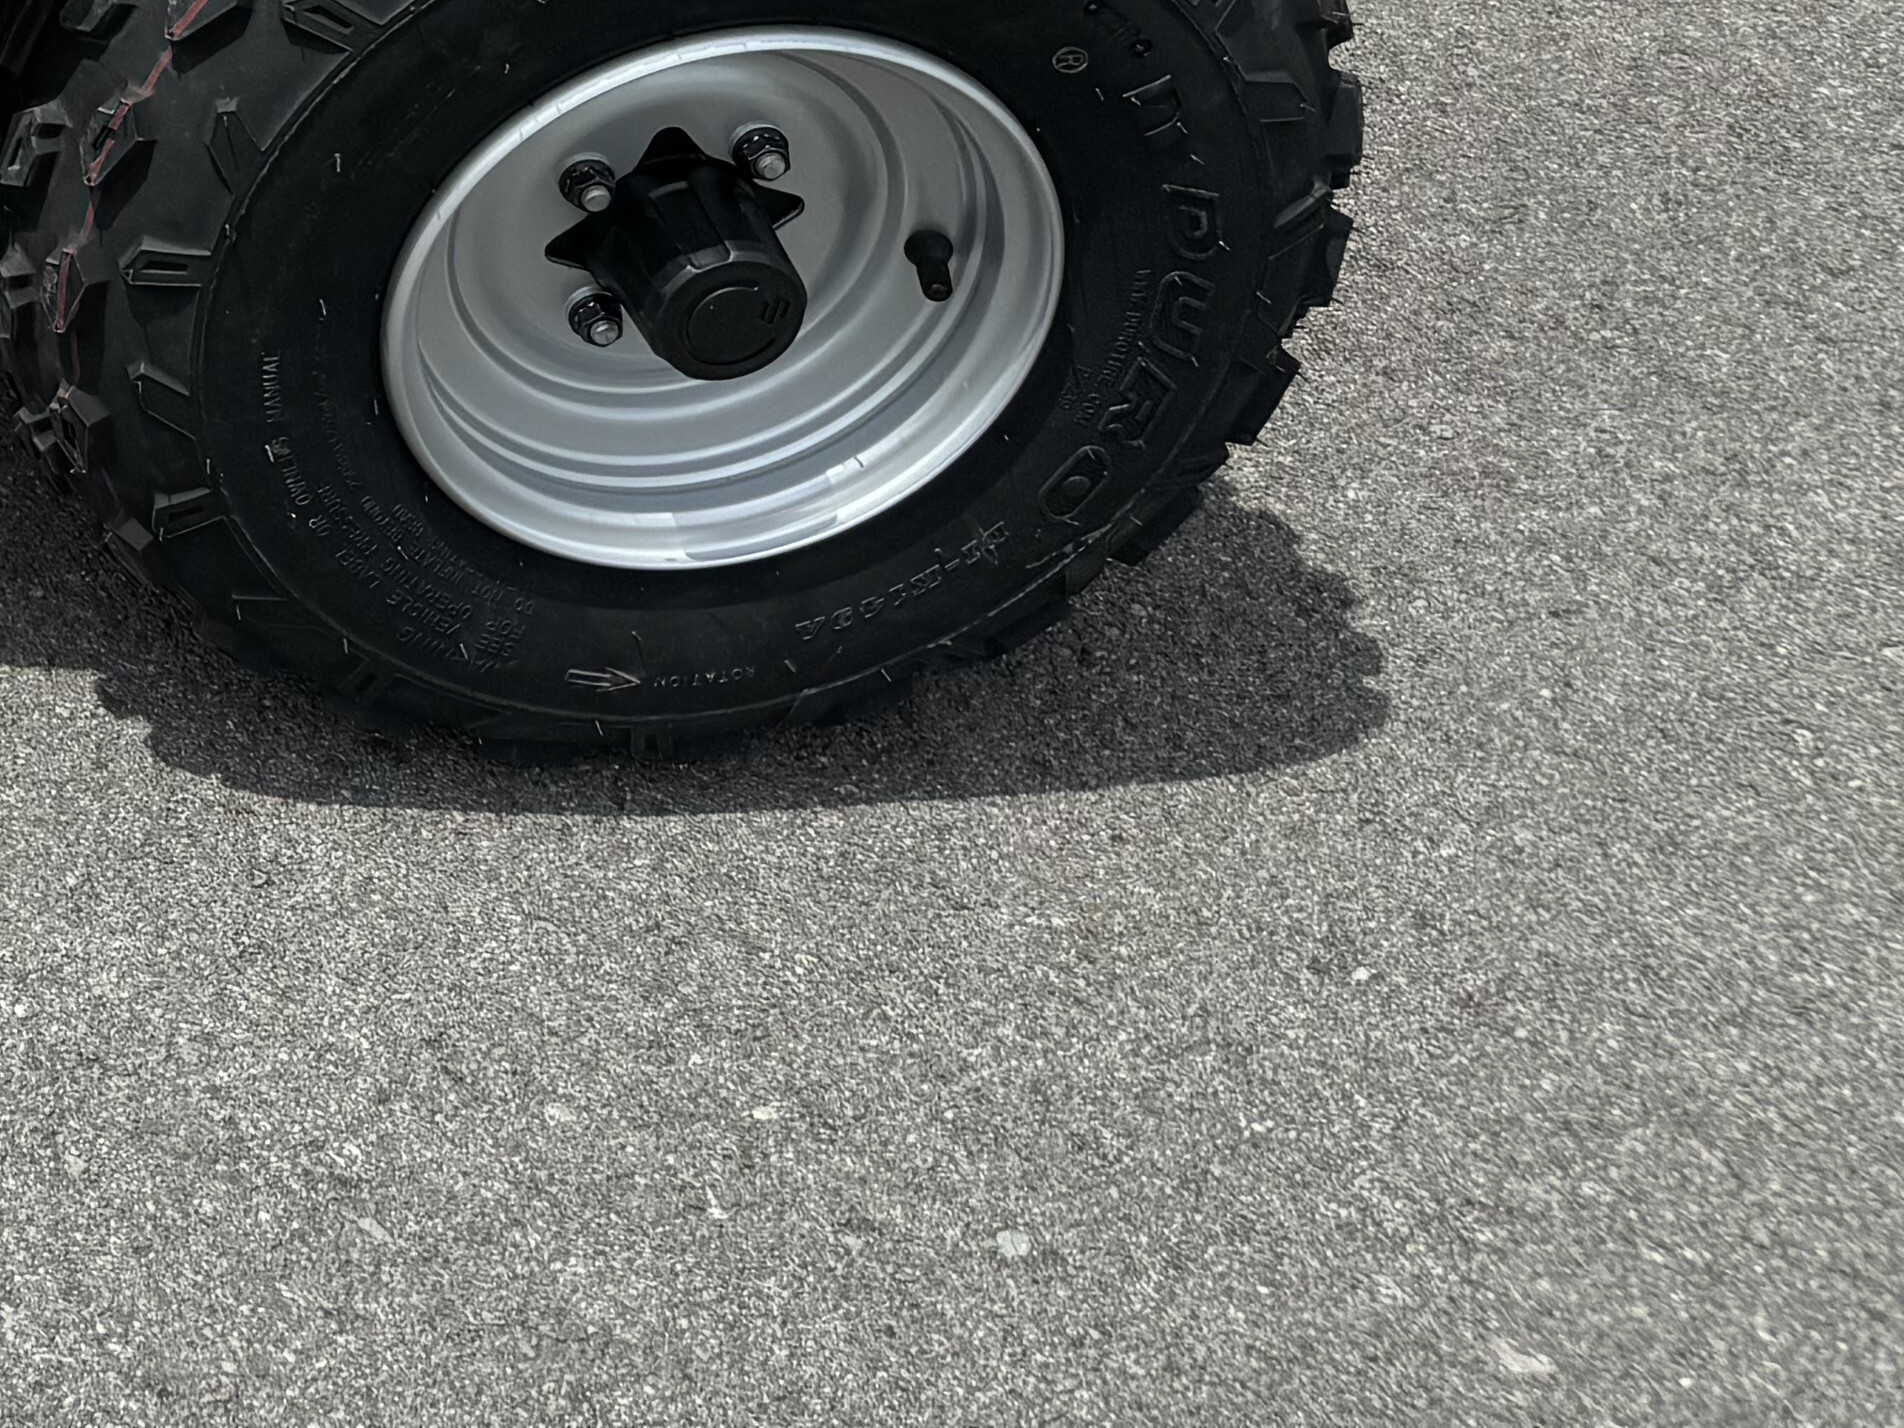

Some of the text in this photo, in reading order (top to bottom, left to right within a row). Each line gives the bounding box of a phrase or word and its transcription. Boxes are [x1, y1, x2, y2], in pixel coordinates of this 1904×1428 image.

[1036, 182, 1234, 526] DURO
[260, 349, 283, 422] MANUAL
[306, 511, 331, 539] OR
[314, 481, 378, 555] PRESSURE
[333, 542, 381, 590] LABEL
[378, 554, 474, 620] OPERATING
[386, 586, 460, 636] VEHICLE
[475, 631, 510, 657] SEE
[651, 664, 756, 689] ROTATION
